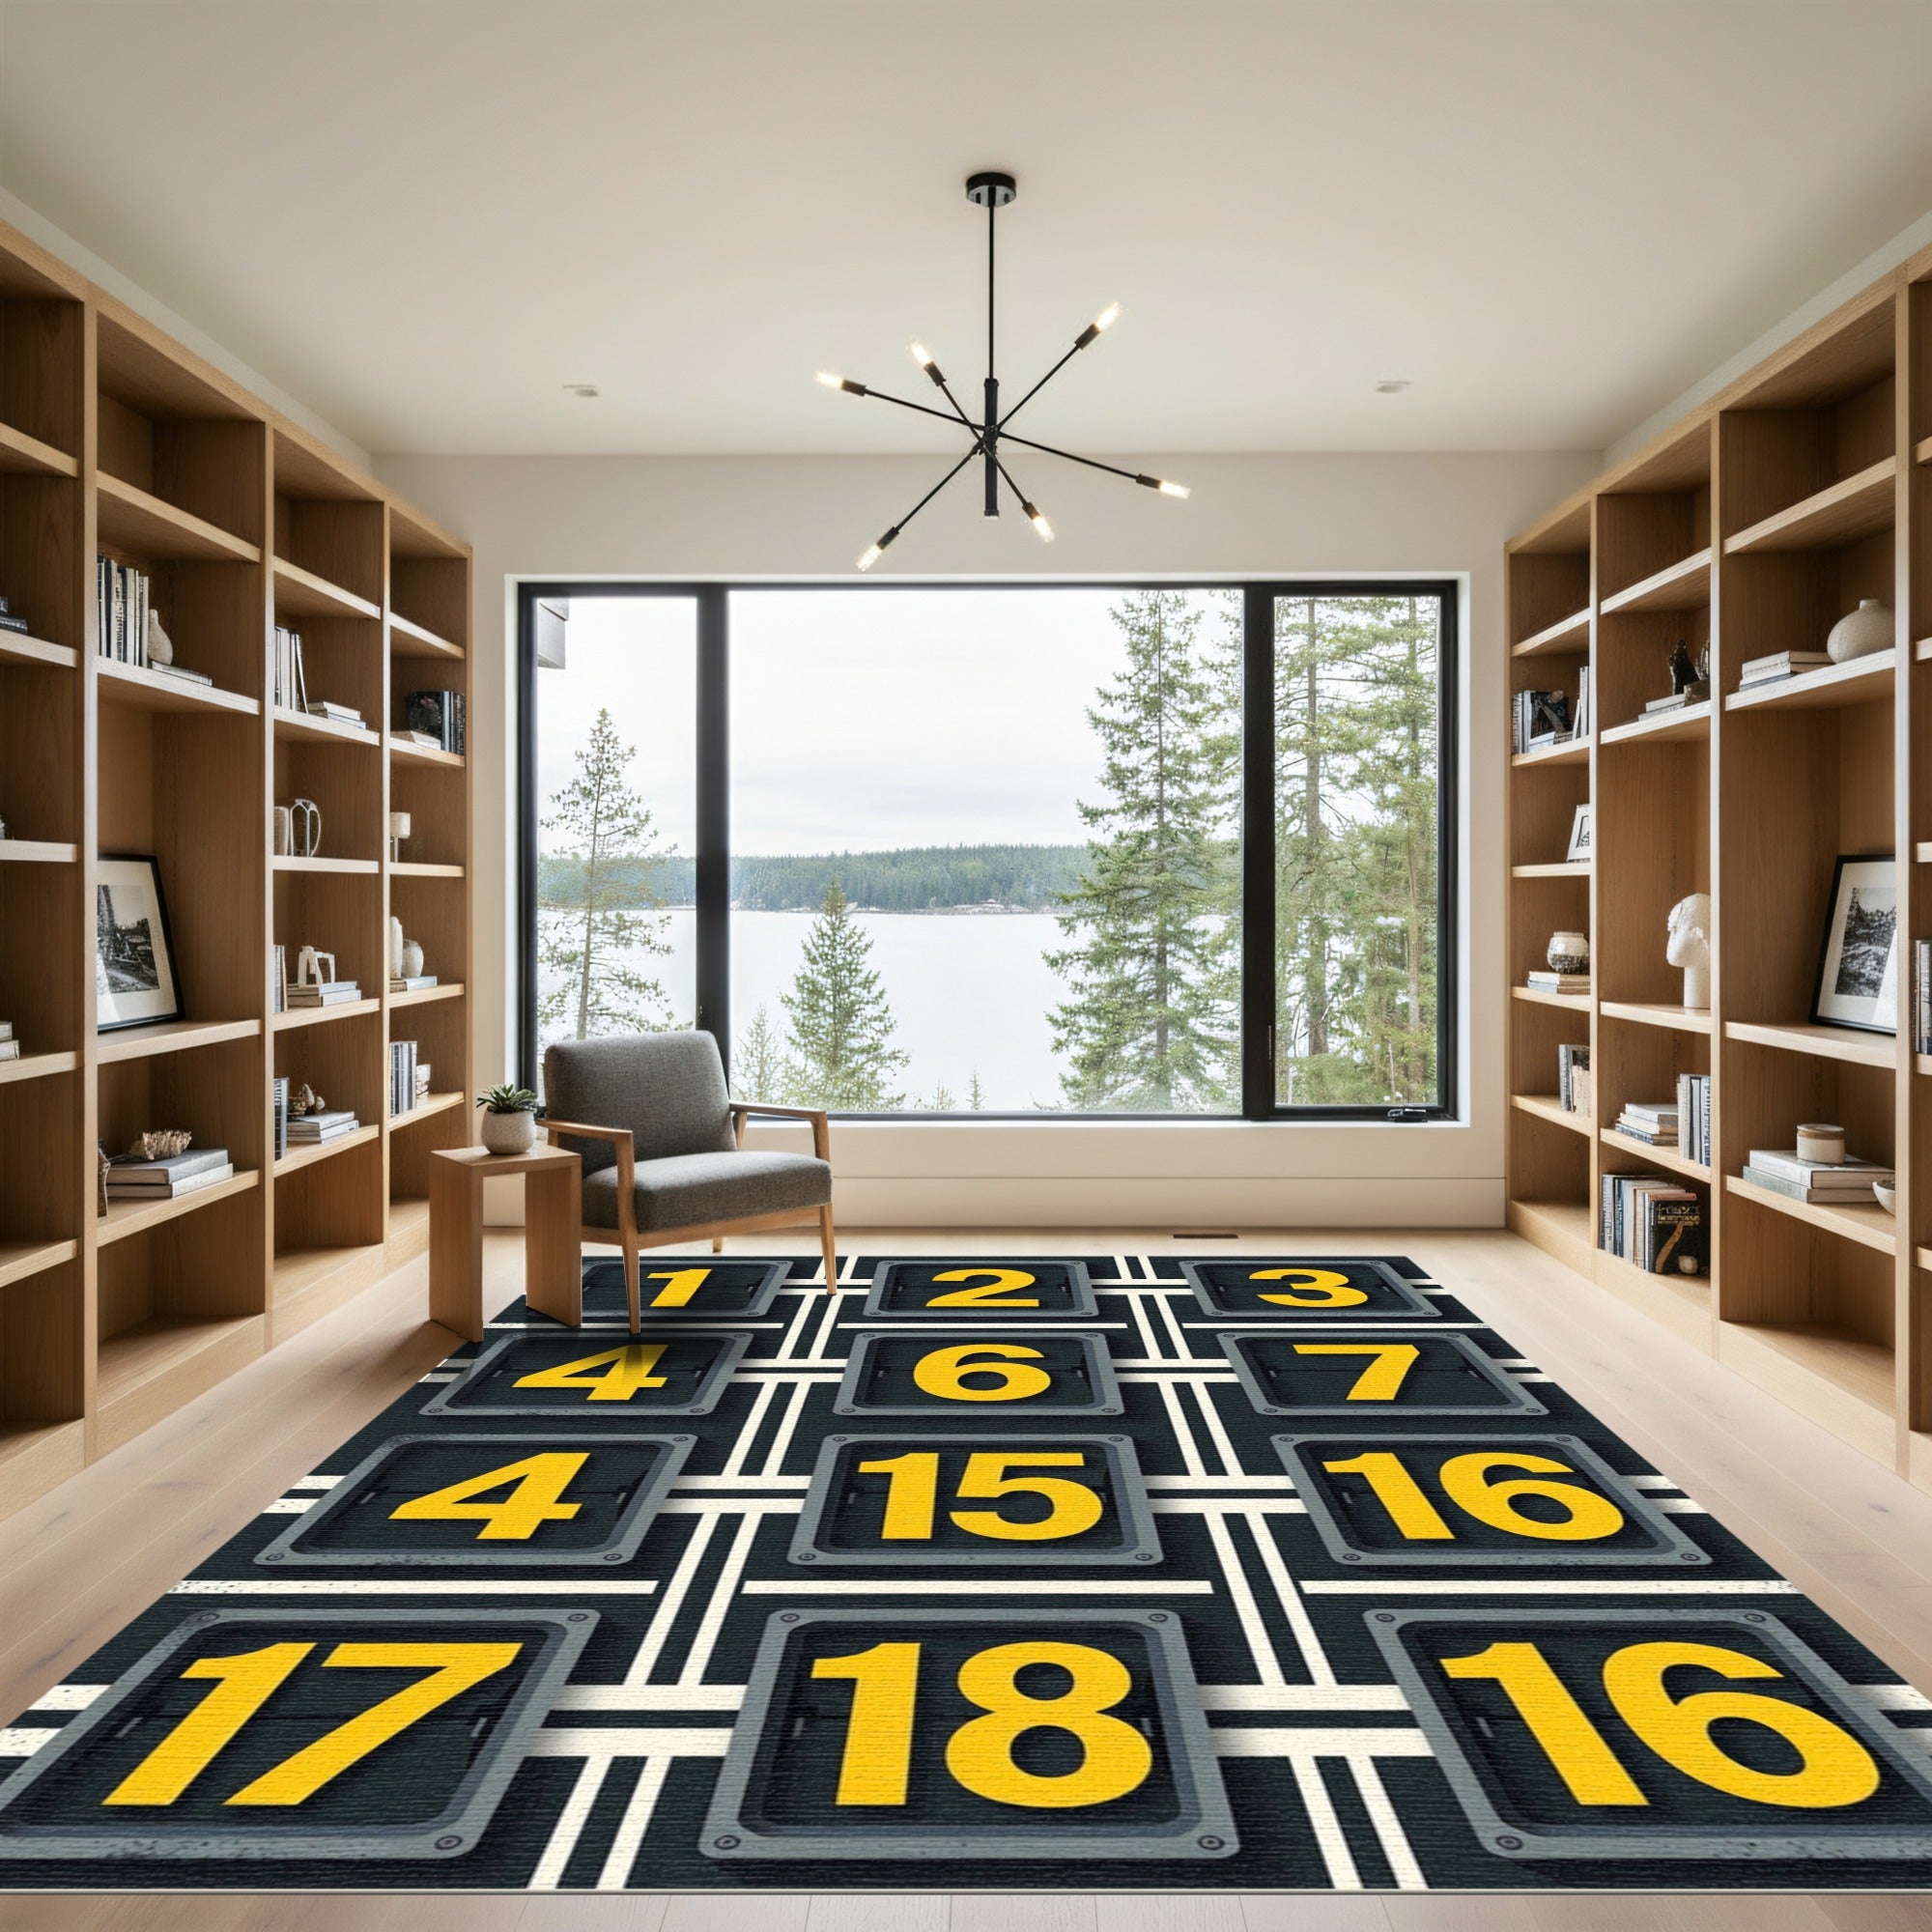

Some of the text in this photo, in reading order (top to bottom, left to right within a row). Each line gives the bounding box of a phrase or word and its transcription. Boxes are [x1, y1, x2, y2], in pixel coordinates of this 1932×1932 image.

[648, 1268, 711, 1308] 1
[925, 1268, 1040, 1308] 2
[1248, 1267, 1368, 1308] 3
[512, 1344, 668, 1402] 4
[913, 1344, 1052, 1402] 6
[1293, 1344, 1421, 1401] 7
[389, 1452, 590, 1541] 4
[858, 1452, 1104, 1542] 15
[1322, 1451, 1625, 1542] 16
[104, 1641, 524, 1807] 17
[810, 1640, 1153, 1809] 18
[1439, 1640, 1882, 1810] 16
